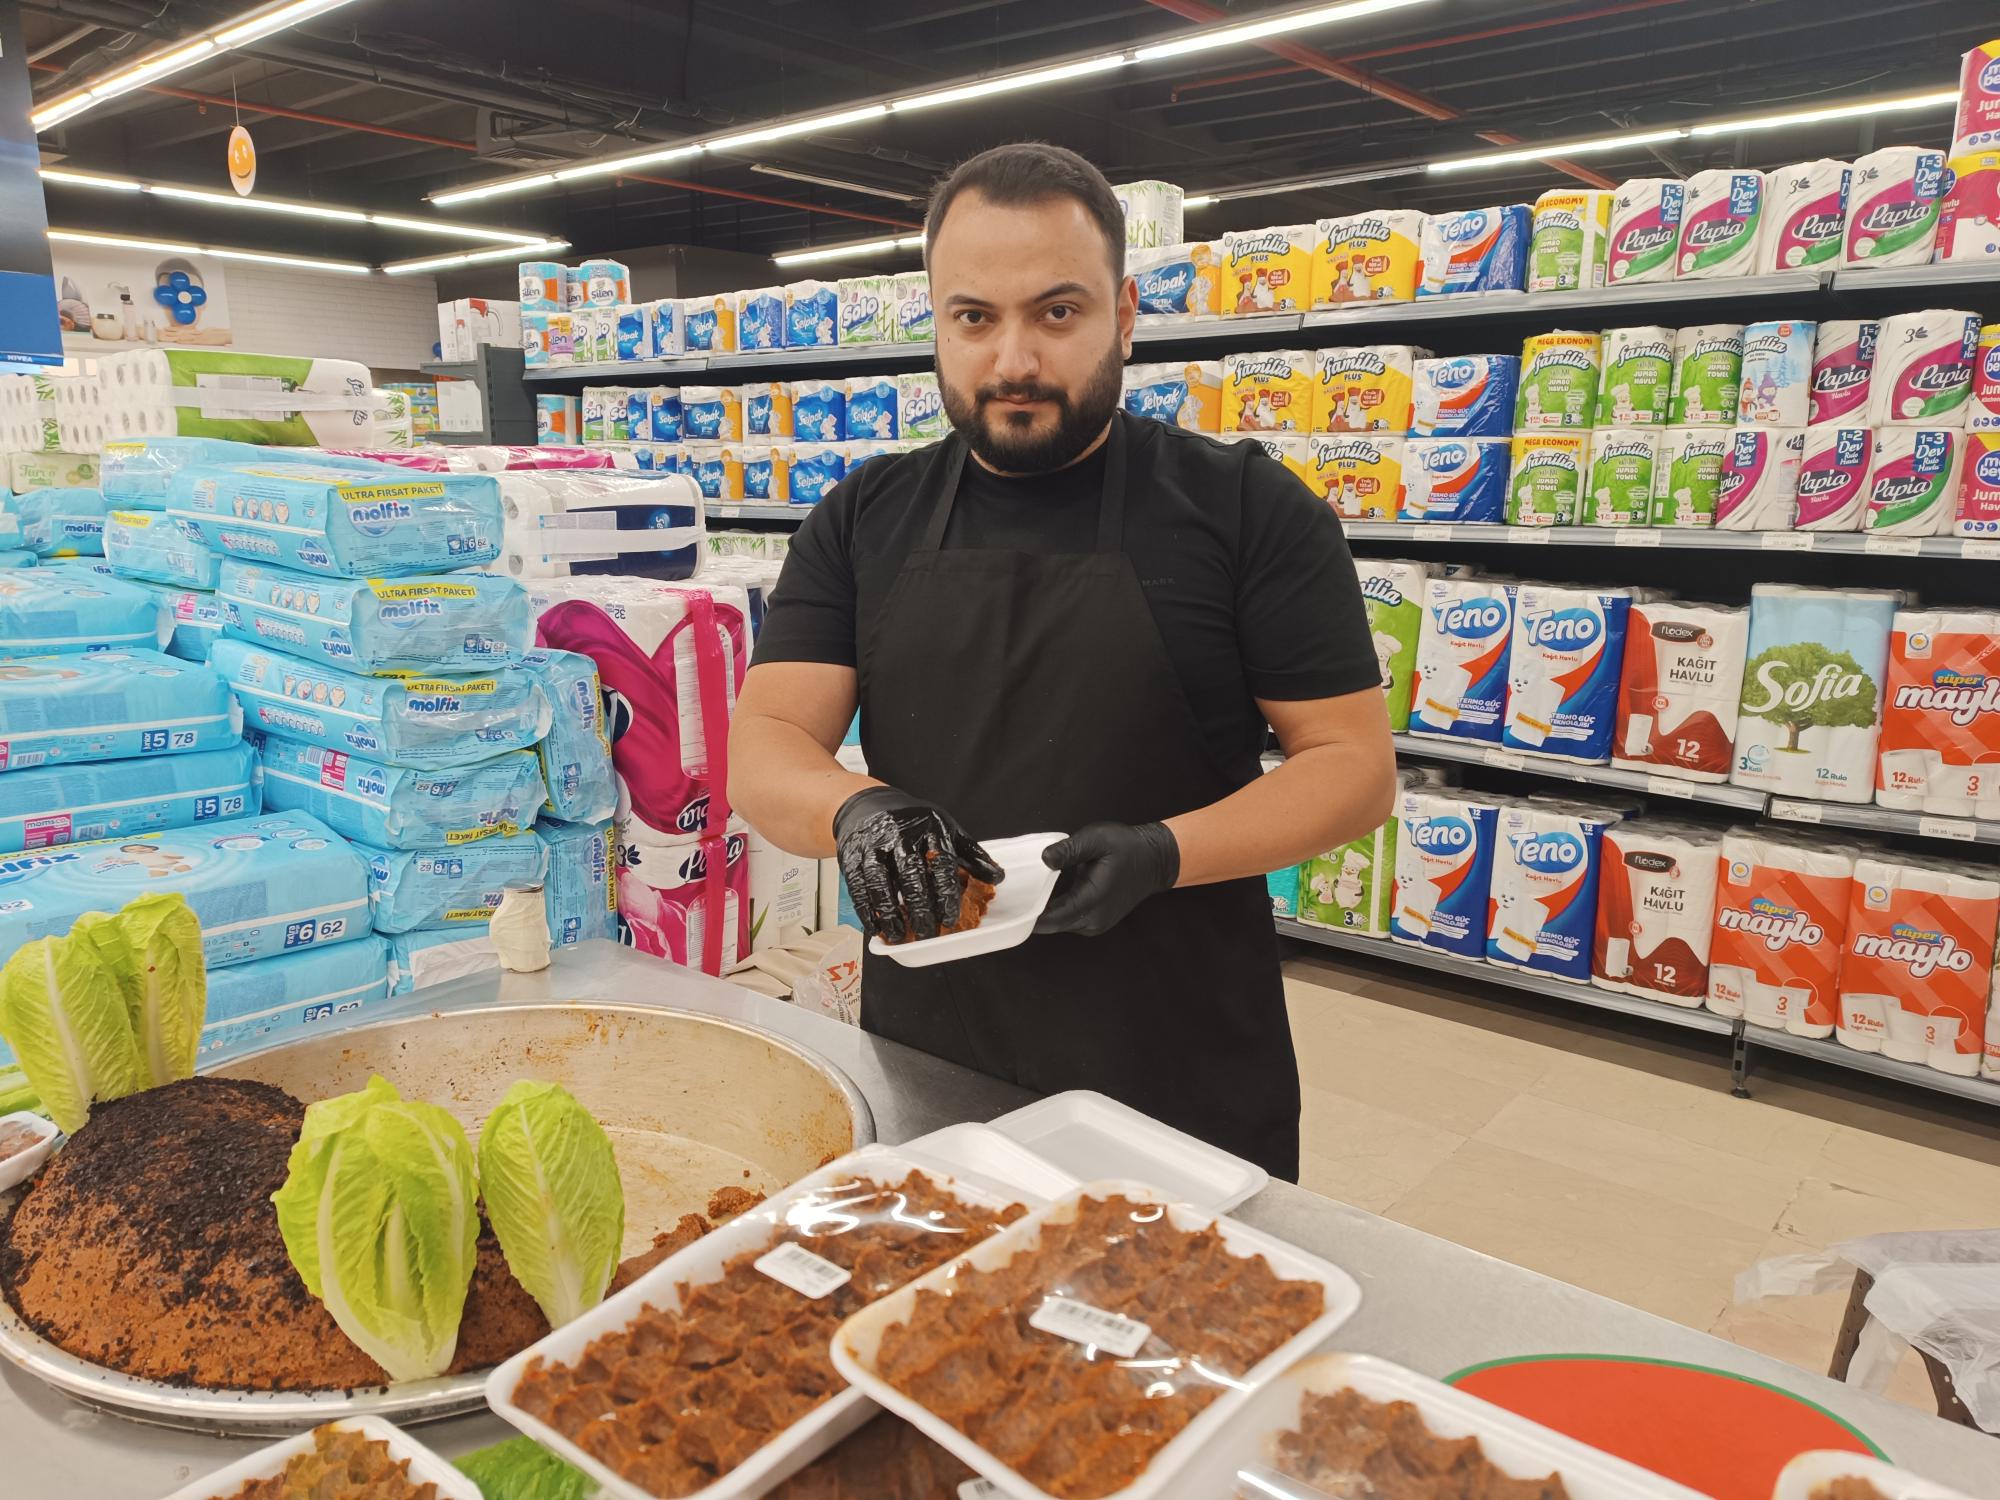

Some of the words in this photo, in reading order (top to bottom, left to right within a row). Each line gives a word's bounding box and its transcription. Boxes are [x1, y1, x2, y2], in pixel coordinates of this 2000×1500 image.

[1920, 156, 1943, 168] 1=3
[1734, 176, 1757, 188] 1=3
[1915, 167, 1942, 182] Dev
[1546, 197, 1585, 208] ECONOMY
[1732, 188, 1757, 203] Dev
[1867, 202, 1929, 229] Papia
[1441, 214, 1484, 242] Teno
[1689, 219, 1743, 244] Papia
[1326, 219, 1391, 254] familia
[1621, 228, 1674, 252] Papia
[1230, 234, 1291, 267] familia
[1349, 241, 1367, 249] PLUS
[1251, 254, 1269, 262] PLUS
[1141, 271, 1187, 297] Selpak
[842, 296, 878, 325] Solo
[7, 354, 33, 363] NIVEA
[1533, 350, 1590, 376] familia
[1617, 343, 1672, 368] familia
[1234, 358, 1291, 387] familia
[1322, 352, 1386, 384] familia
[1429, 363, 1473, 388] Teno
[1919, 363, 1972, 388] Papia
[1817, 365, 1870, 388] Papia
[906, 393, 941, 418] Solo
[1143, 388, 1180, 411] Selpak
[695, 409, 720, 425] Selpak
[798, 409, 823, 425] Selpak
[852, 407, 878, 423] Selpak
[1542, 438, 1579, 447] ECONOMY
[1737, 433, 1756, 444] 1=2
[1841, 432, 1863, 442] 1=2
[1920, 432, 1944, 444] 1=3
[1316, 441, 1380, 470] familia
[1602, 443, 1653, 464] familia
[1735, 443, 1756, 456] Dev
[1839, 441, 1864, 454] Dev
[1916, 444, 1944, 459] Dev
[1420, 447, 1466, 471] Teno
[1525, 452, 1576, 475] familia
[1923, 456, 1939, 465] Rulo
[1918, 463, 1940, 472] Havlu
[796, 473, 824, 488] Selpak
[1800, 470, 1849, 492] Papia
[342, 490, 373, 500] ULTRA
[375, 488, 410, 498] FIRSAT
[411, 485, 443, 496] PAKETİ
[1873, 477, 1929, 501] Papia
[352, 503, 411, 522] molfix
[65, 523, 103, 534] molfix
[379, 588, 407, 599] ULTRA
[408, 586, 442, 597] FIRSAT
[443, 586, 475, 597] PAKETİ
[381, 600, 442, 618] molfix
[1602, 597, 1612, 606] 12
[1436, 600, 1500, 634] Teno
[1527, 609, 1595, 646] Teno
[1677, 655, 1717, 671] KAĞIT
[1669, 668, 1715, 683] HAVLU
[1936, 672, 1983, 687] süper
[466, 682, 494, 691] PAKETİ
[1743, 660, 1863, 715] Sofia
[409, 698, 460, 712] molfix
[1459, 697, 1484, 706] TERMO
[1551, 712, 1577, 722] TERMO
[153, 733, 166, 745] 5
[175, 732, 194, 744] 78
[1676, 738, 1700, 759] 12
[1739, 757, 1748, 770] 3
[1816, 768, 1829, 779] 12
[1830, 773, 1848, 781] Rulo
[1892, 772, 1906, 783] 12
[1967, 776, 1980, 791] 3
[205, 800, 217, 813] 5
[224, 797, 242, 810] 78
[1472, 808, 1482, 817] 12
[1409, 816, 1466, 847] Teno
[1584, 823, 1593, 832] 12
[1511, 832, 1576, 866] Teno
[1650, 885, 1686, 900] KAĞIT
[1643, 896, 1684, 912] HAVLU
[1753, 900, 1794, 916] süper
[1345, 911, 1354, 926] 3
[1430, 910, 1454, 921] TERMO
[300, 925, 313, 939] 6
[321, 920, 343, 935] 62
[1536, 930, 1561, 941] TERMO
[1719, 907, 1824, 951] maylo
[1894, 925, 1939, 943] süper
[1853, 932, 1973, 978] maylo
[1654, 963, 1676, 984] 12
[1715, 983, 1726, 996] 12
[1727, 987, 1741, 998] Rulo
[1777, 996, 1788, 1011] 3
[1852, 1012, 1866, 1026] 12
[1867, 1018, 1884, 1029] Rulo
[1925, 1025, 1935, 1040] 3
